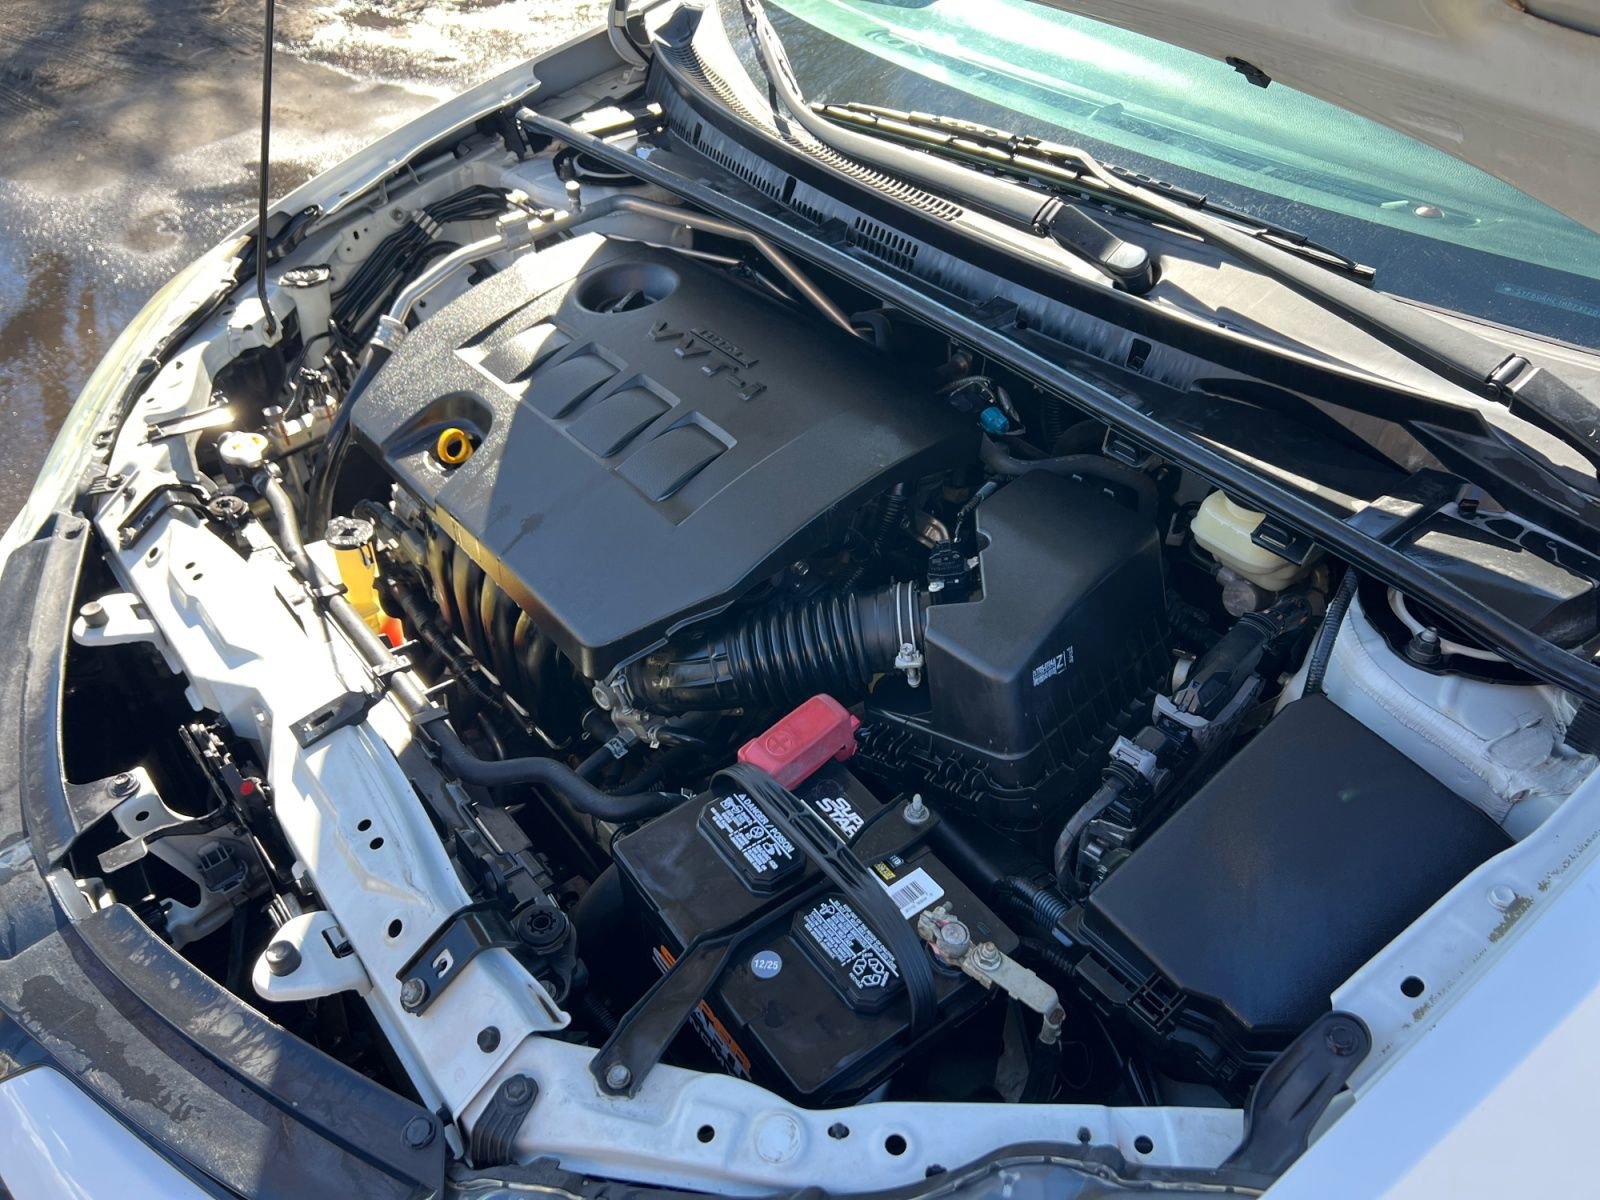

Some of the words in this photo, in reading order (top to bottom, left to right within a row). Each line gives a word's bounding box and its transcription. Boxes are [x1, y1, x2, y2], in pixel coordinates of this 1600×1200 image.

[744, 798, 769, 825] DANGER
[769, 827, 795, 853] POISON
[815, 797, 858, 839] STAR
[835, 797, 865, 829] SUP
[754, 959, 779, 970] 12/25
